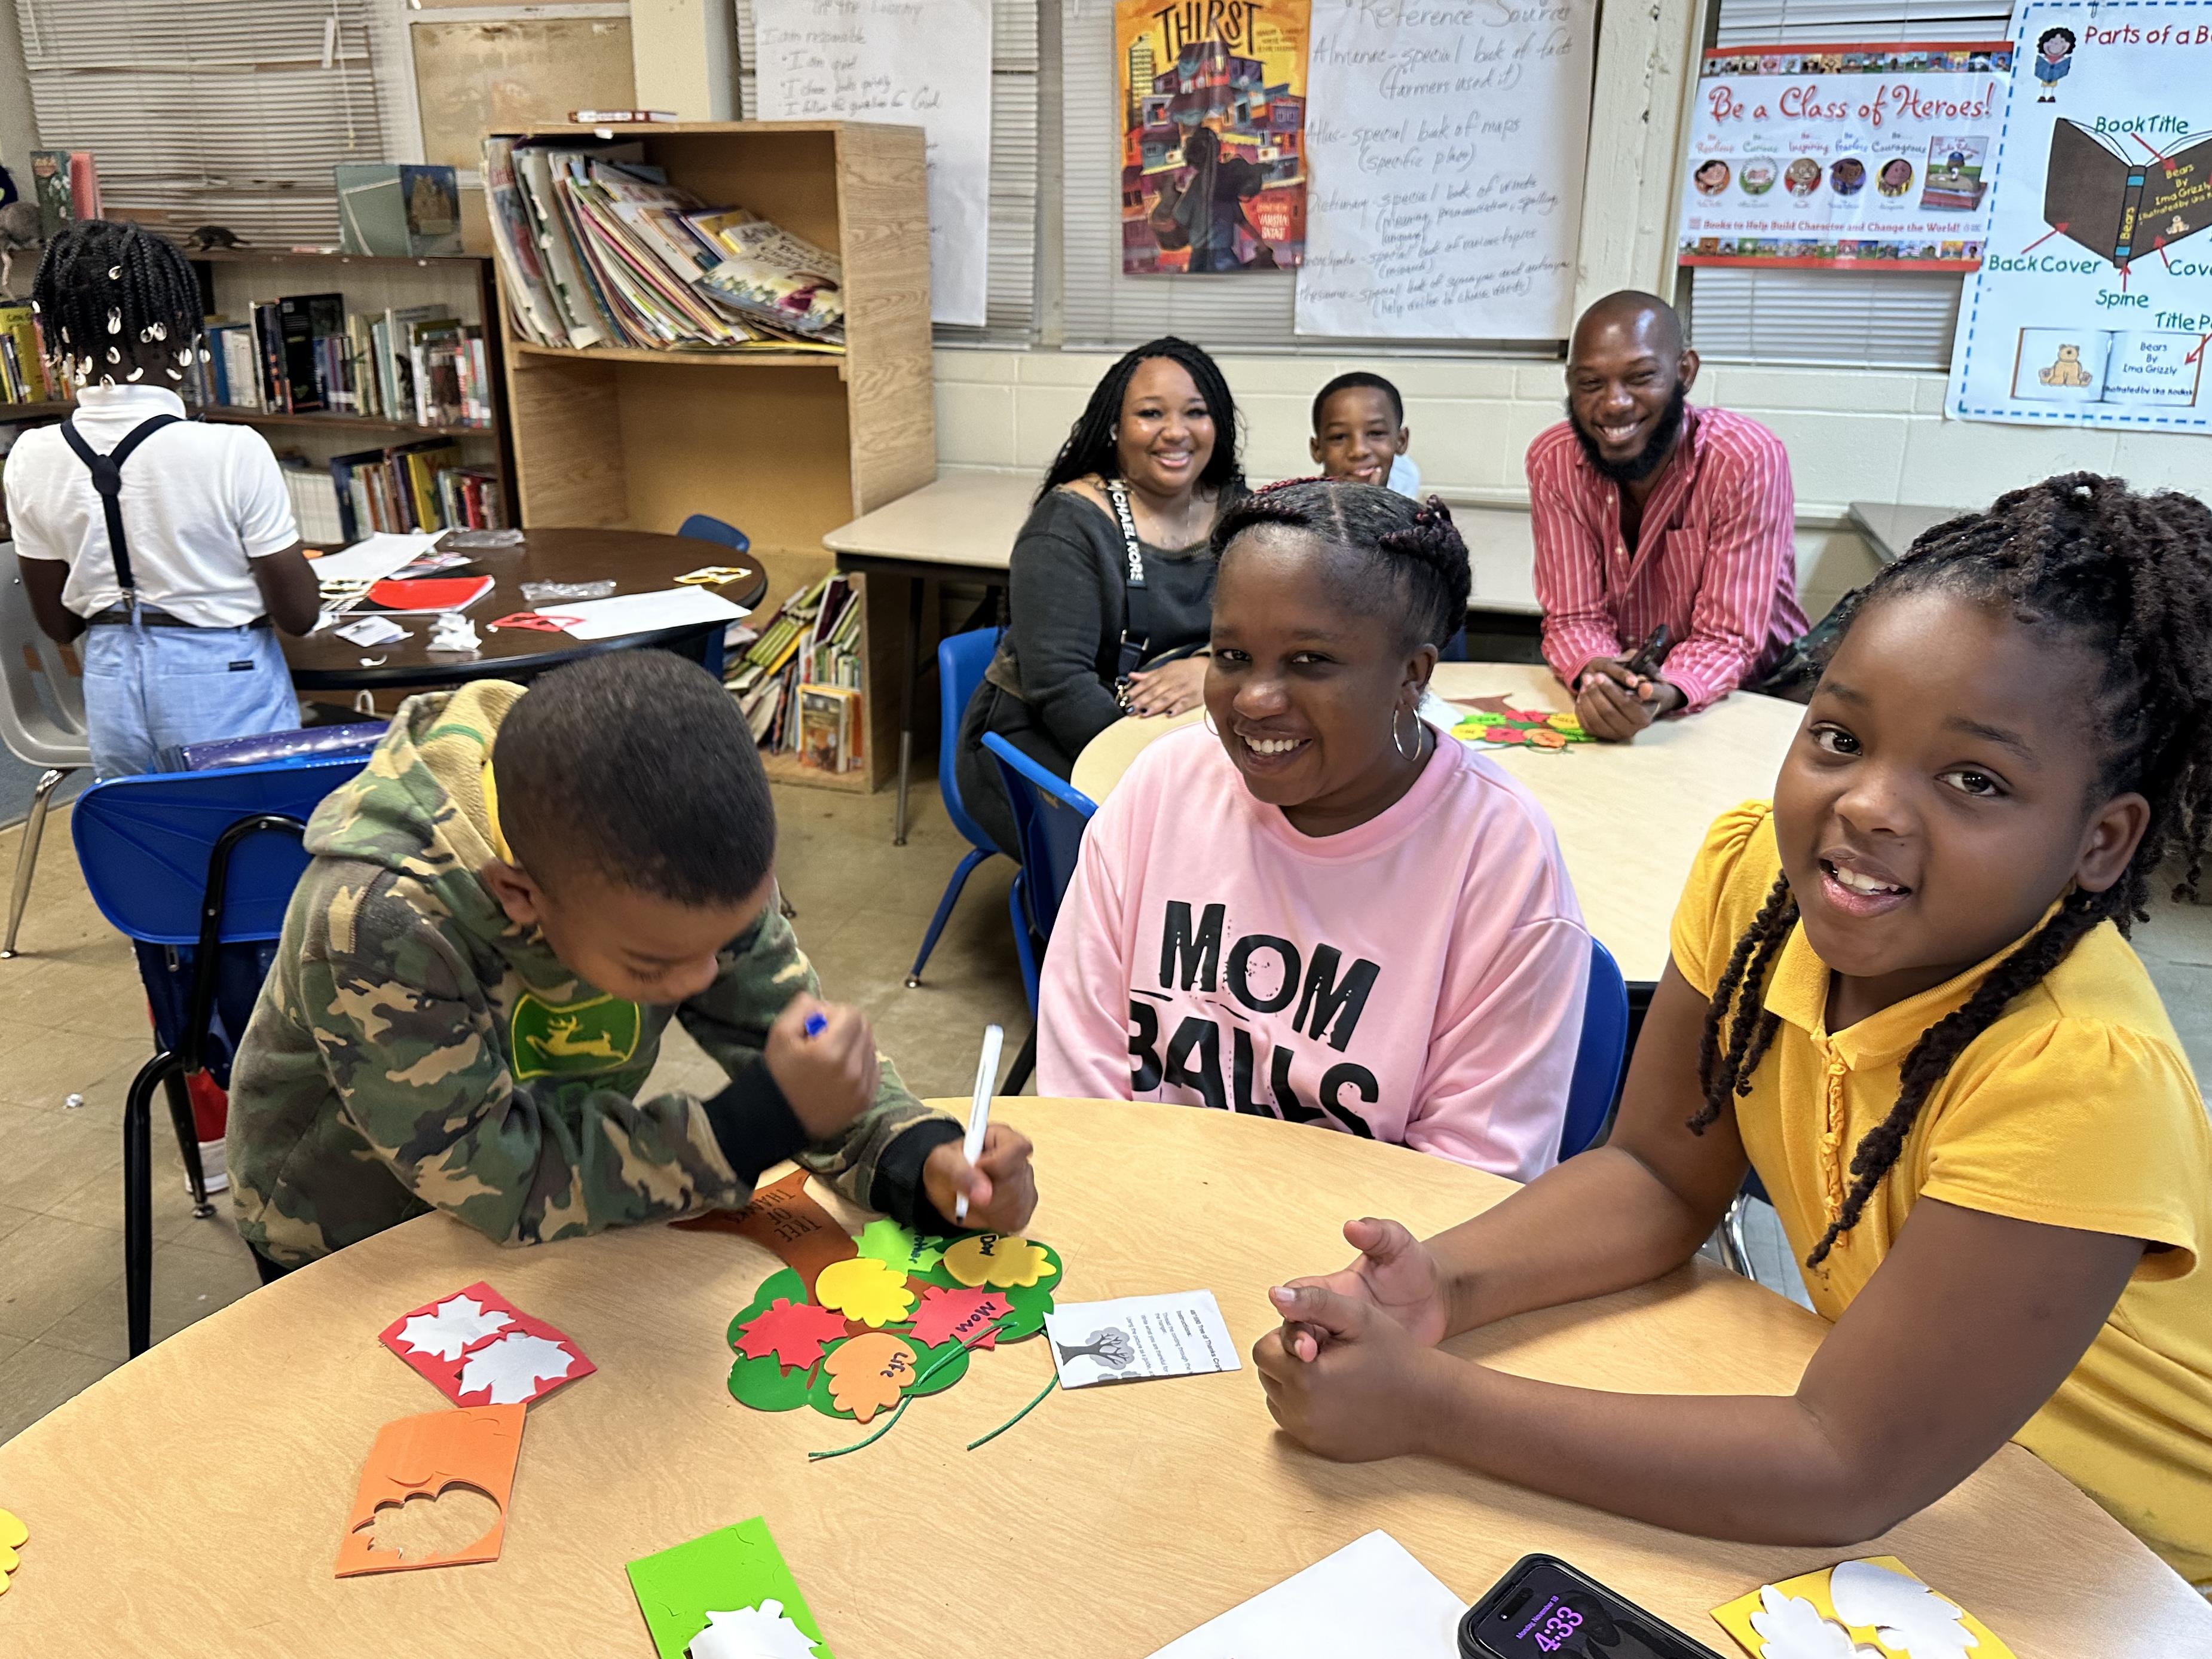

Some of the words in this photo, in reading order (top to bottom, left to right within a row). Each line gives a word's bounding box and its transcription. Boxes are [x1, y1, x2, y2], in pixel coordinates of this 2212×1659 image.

[1153, 0, 1263, 62] THIRST
[2085, 24, 2140, 45] Parts
[2146, 24, 2174, 45] of
[2176, 30, 2190, 45] a
[2195, 26, 2212, 45] B
[1708, 85, 1744, 122] Be
[1752, 102, 1767, 119] a
[1779, 83, 1848, 120] Class
[1858, 84, 1885, 127] of
[1890, 82, 1995, 120] Heroes!
[2095, 115, 2145, 135] Book
[2144, 115, 2189, 135] Title
[2165, 164, 2195, 179] Bears
[2175, 178, 2189, 188] By
[1703, 219, 1732, 230] Books
[1733, 220, 1743, 230] to
[1746, 219, 1769, 233] Help
[1770, 220, 1797, 231] Build
[1797, 221, 1845, 233] Character
[1846, 222, 1865, 232] and
[1867, 223, 1904, 236] Change
[1907, 223, 1924, 233] the
[1926, 223, 1961, 233] World!
[2119, 206, 2135, 240] Bears
[1987, 254, 2038, 272] Back
[2040, 255, 2103, 275] Cover
[2167, 258, 2212, 276] Cov
[2095, 289, 2150, 310] Spine
[2155, 311, 2196, 331] Title
[2199, 314, 2212, 331] P
[2140, 341, 2168, 353] Bears
[2146, 353, 2159, 364] By
[2144, 364, 2179, 377] Grizzly
[1107, 479, 1136, 540] MCHAEL
[1125, 540, 1145, 581] KORS
[1159, 900, 1381, 1053] MOM
[1128, 998, 1380, 1140] BALLS
[767, 1207, 793, 1226] OF
[773, 1215, 823, 1243] TREE
[955, 1301, 997, 1333] Mom
[1205, 1339, 1216, 1358] Thanks
[880, 1352, 908, 1378] Life
[1534, 1606, 1584, 1652] 4:33
